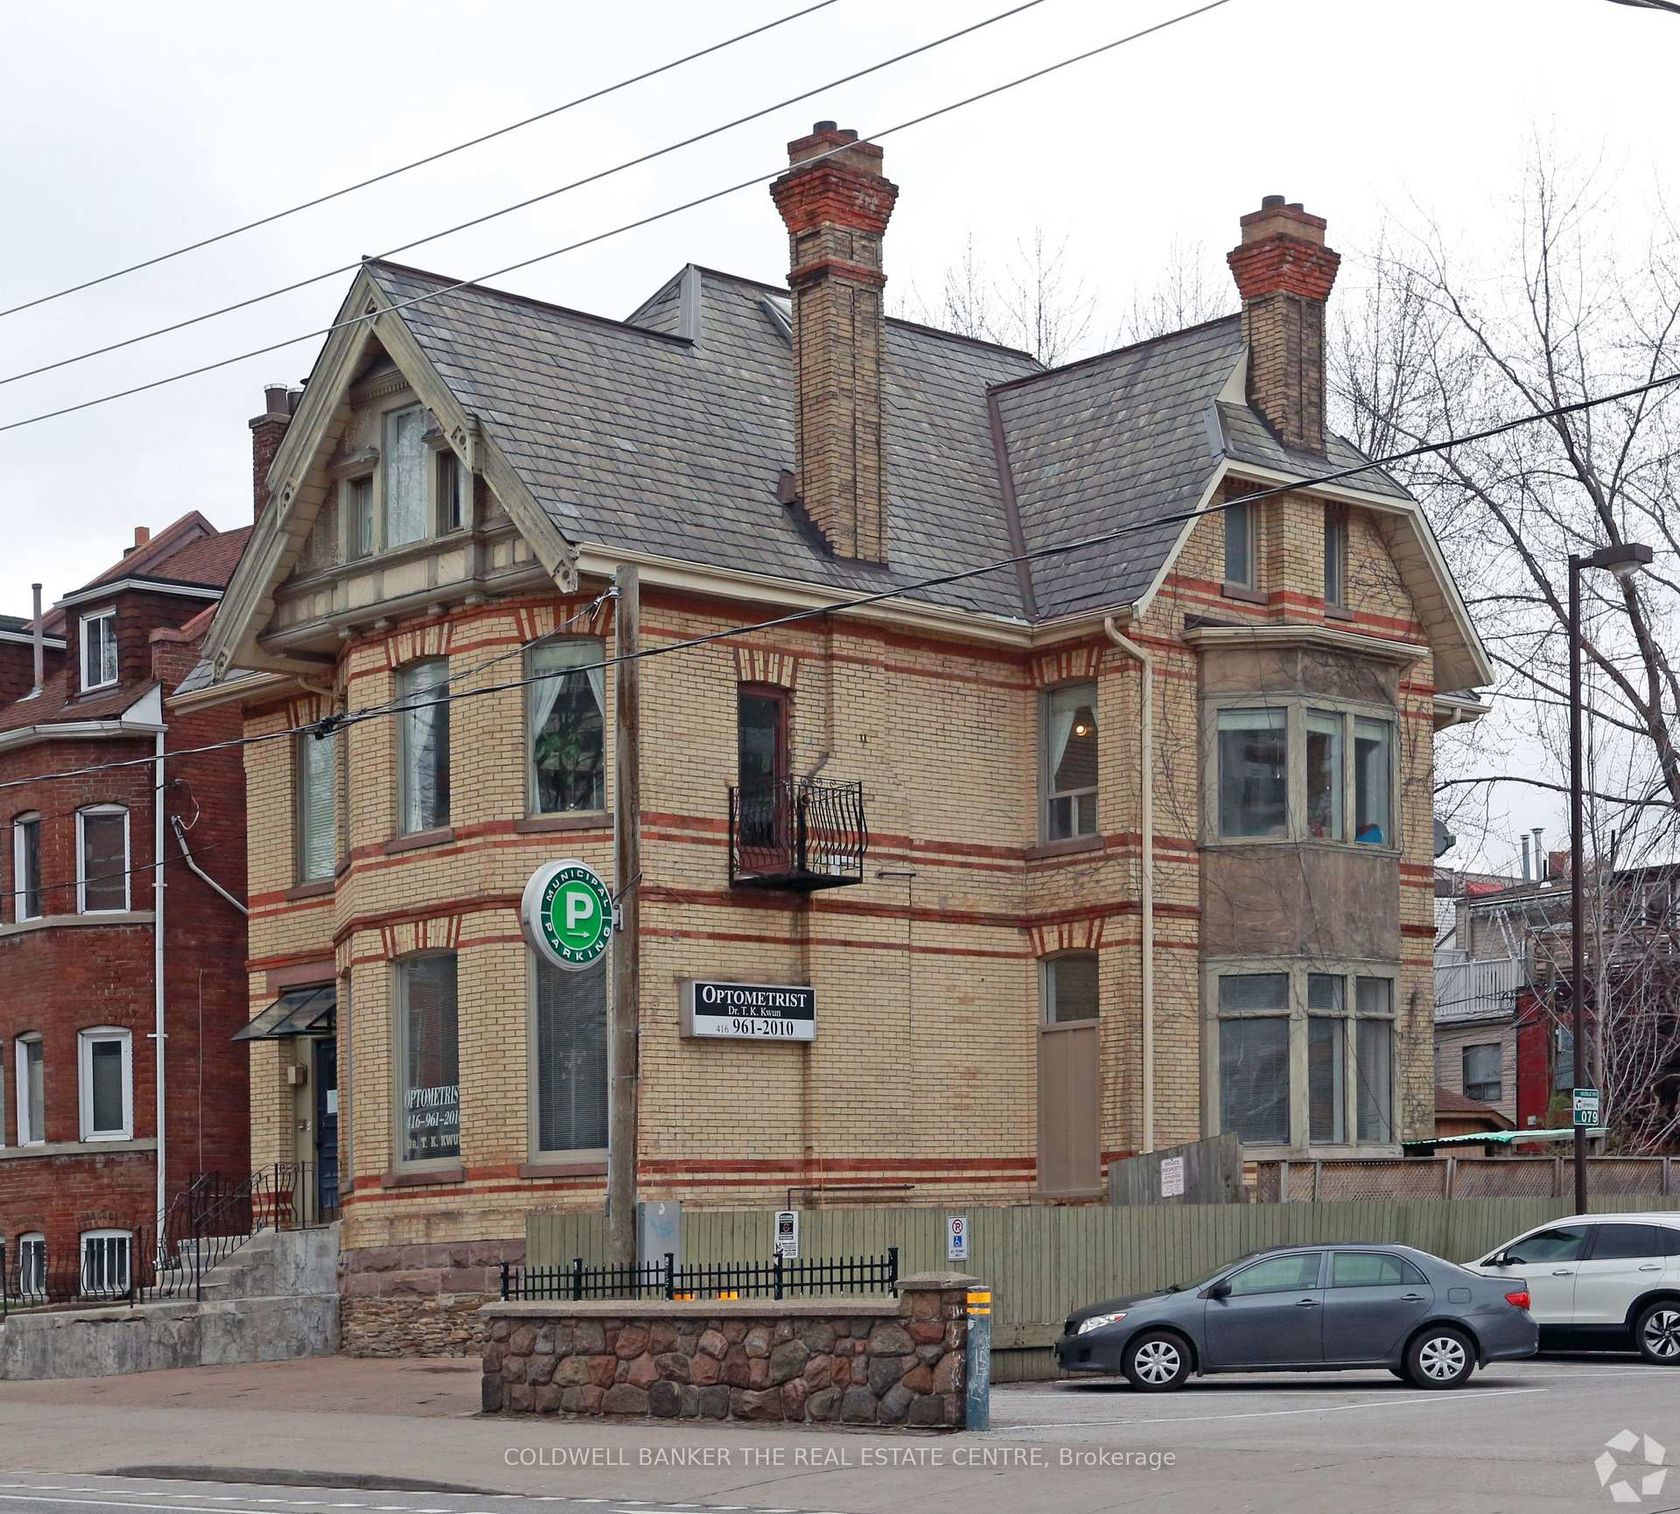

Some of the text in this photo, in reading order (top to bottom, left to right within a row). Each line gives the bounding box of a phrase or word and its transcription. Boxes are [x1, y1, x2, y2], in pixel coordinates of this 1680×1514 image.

[546, 869, 610, 908] MUNICIPAL
[566, 891, 595, 930] P
[545, 922, 611, 961] PARKING
[728, 1006, 782, 1018] Dr. T. K. Kwun
[716, 1018, 794, 1036] 416 961-2010
[1581, 1111, 1598, 1123] 079
[421, 1136, 428, 1148] T.
[431, 1135, 439, 1148] K.
